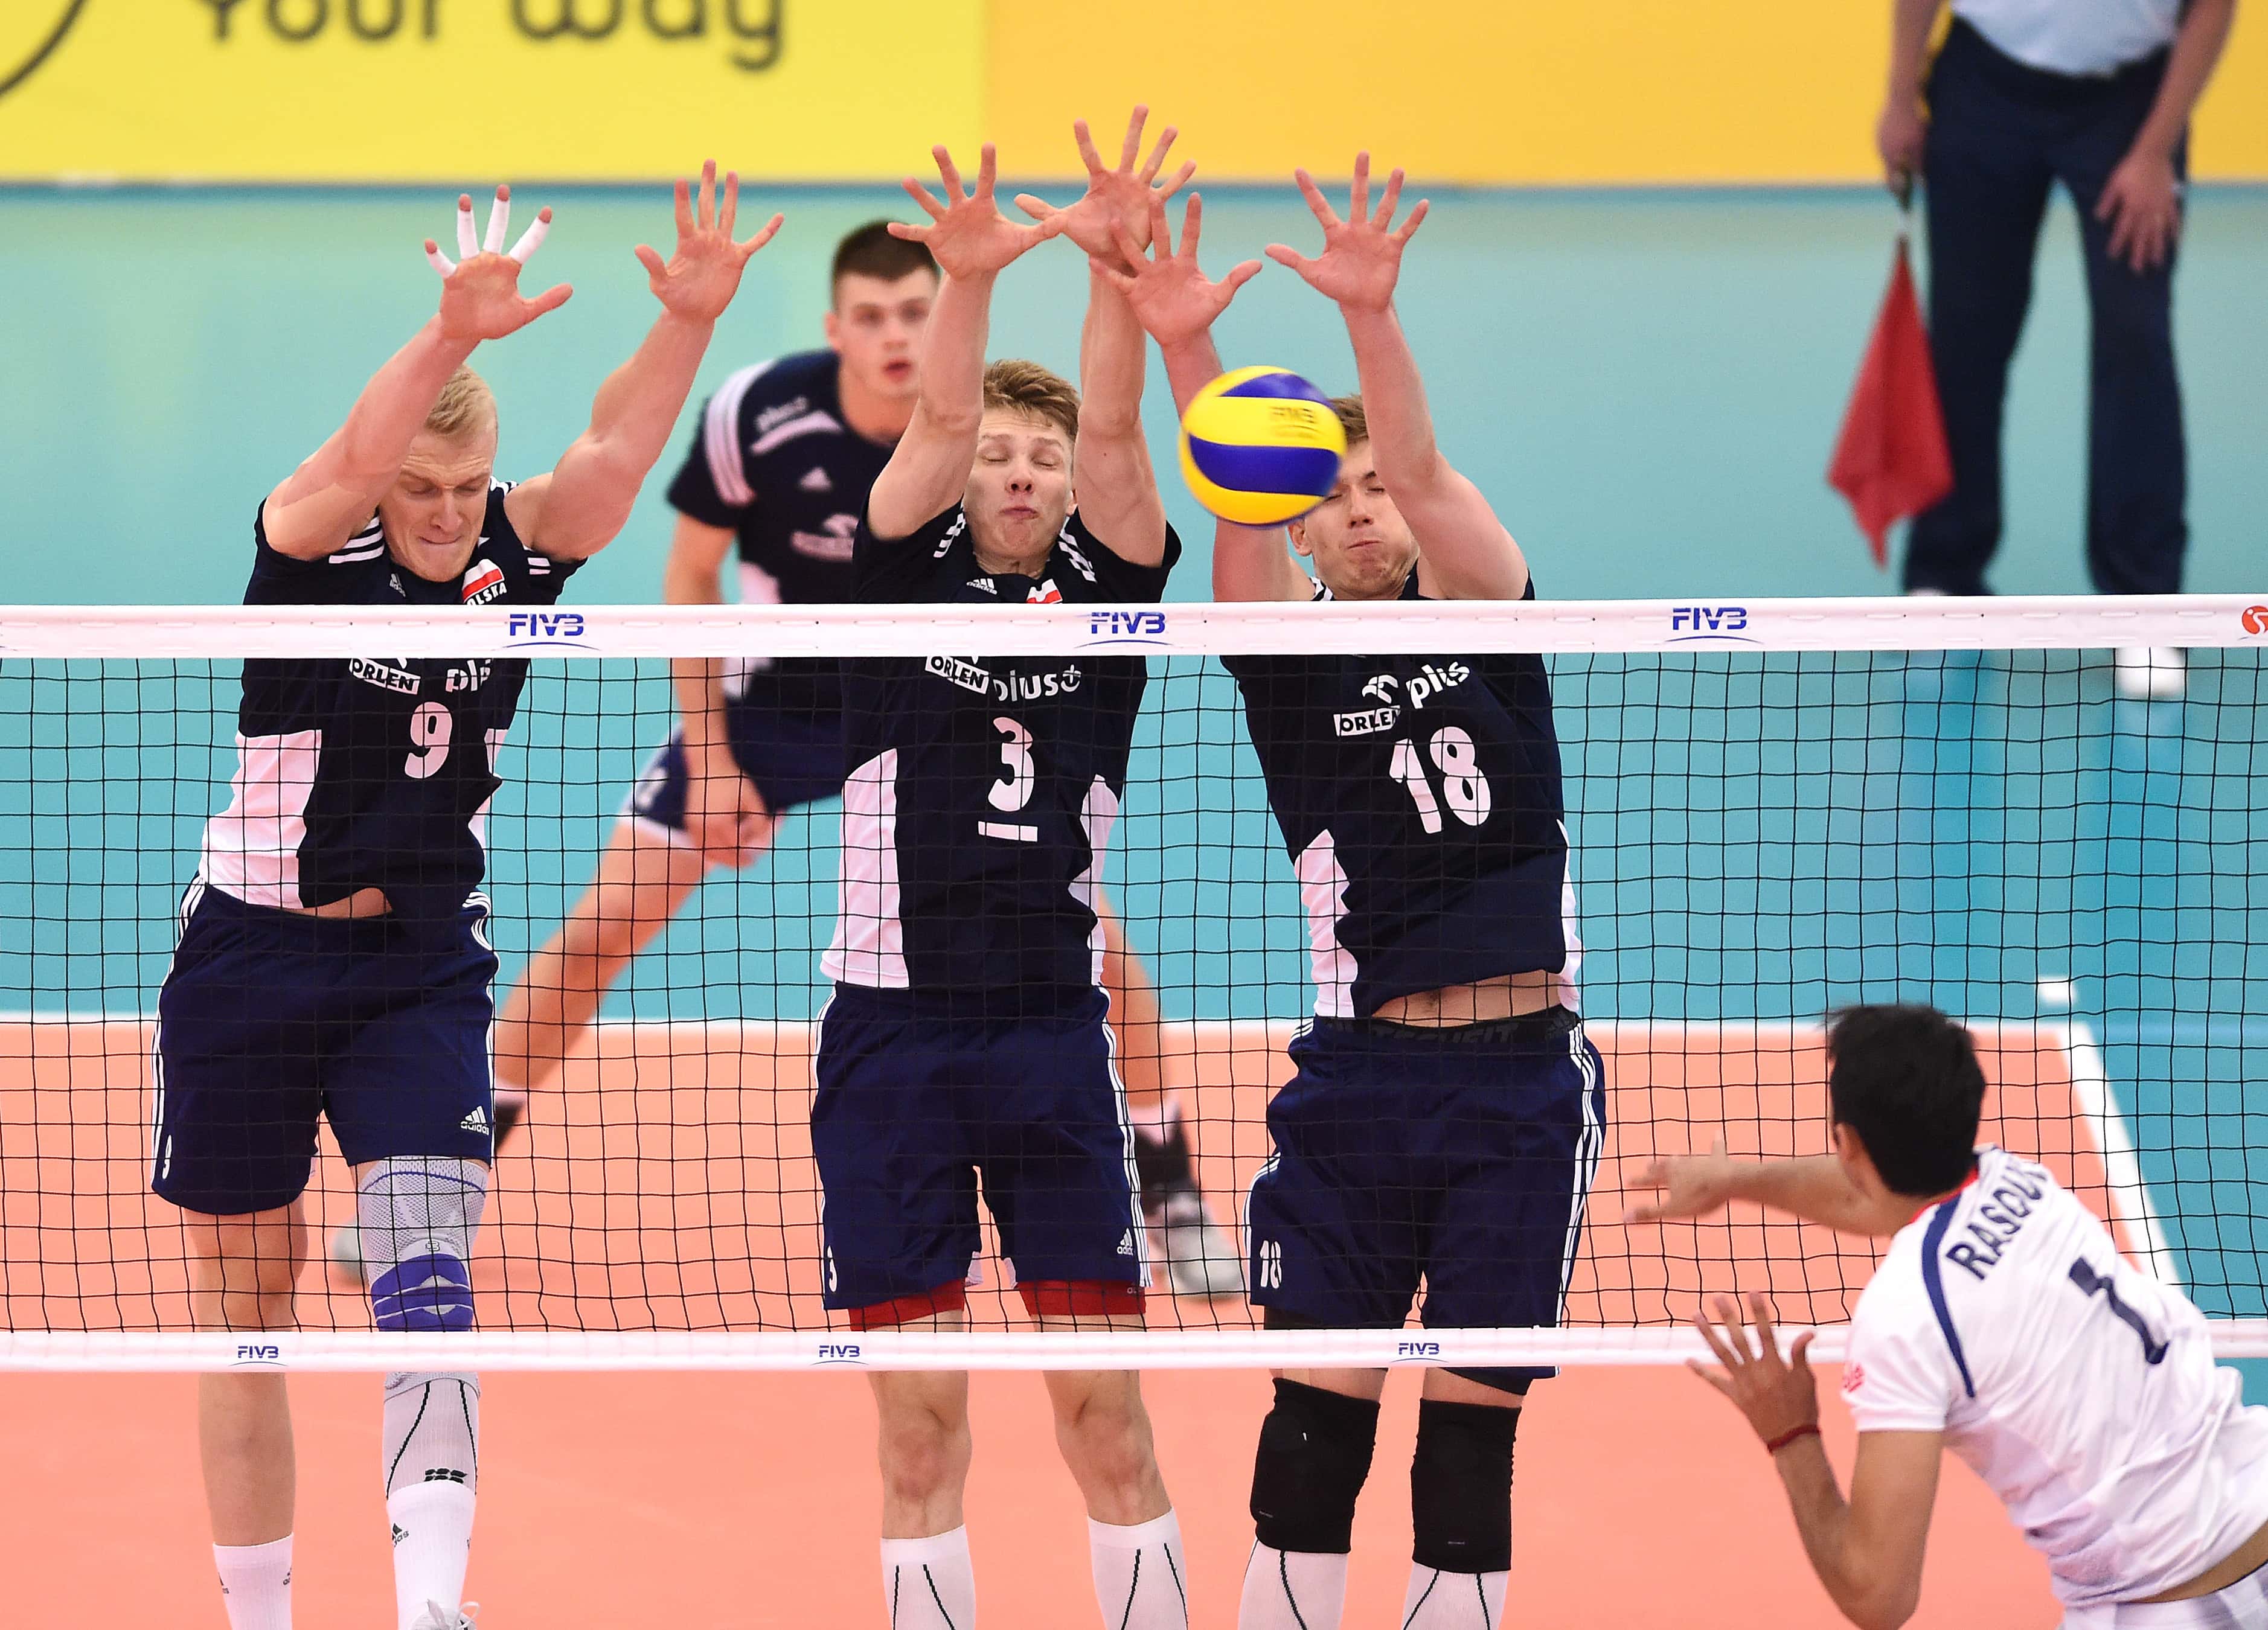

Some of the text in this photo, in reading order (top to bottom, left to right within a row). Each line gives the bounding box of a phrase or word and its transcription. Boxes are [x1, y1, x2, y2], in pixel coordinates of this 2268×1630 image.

[467, 582, 507, 604] OLSKA
[509, 613, 585, 637] FIVB
[1091, 612, 1165, 634] FIVB
[1672, 607, 1747, 631] FIVB
[351, 657, 414, 691] ORLEN
[931, 656, 984, 689] ORLEN
[404, 702, 453, 779] 9
[987, 717, 1034, 811] 3
[1389, 726, 1491, 834] 18
[1260, 1240, 1282, 1290] 18
[237, 1346, 279, 1359] FIVB
[819, 1345, 860, 1358] FIVB
[1398, 1343, 1440, 1355] FIVB
